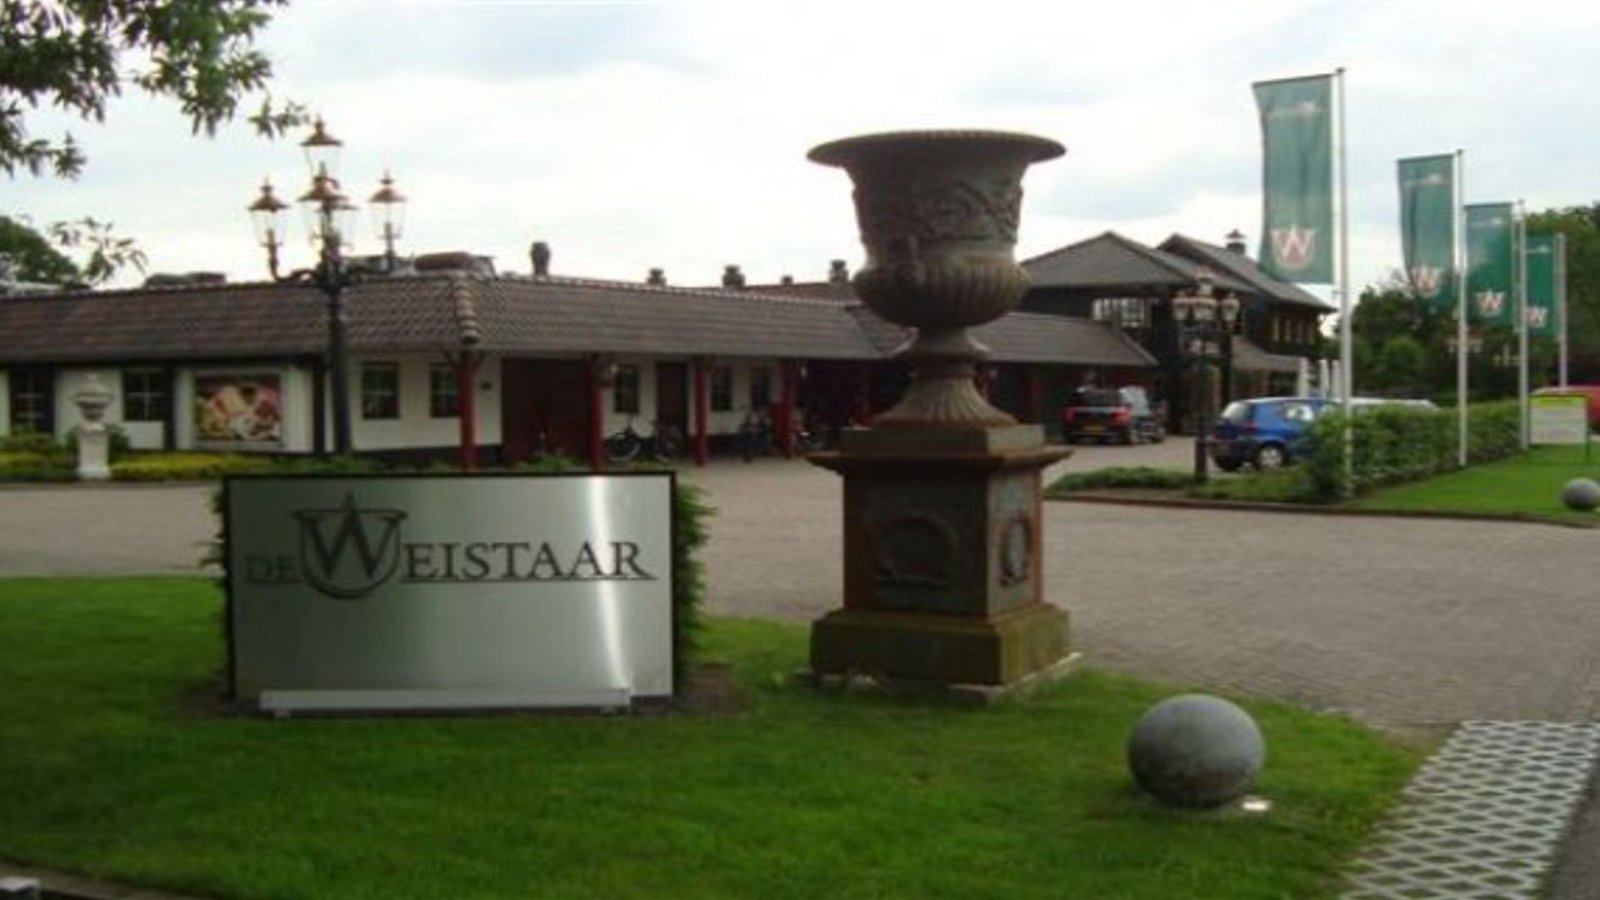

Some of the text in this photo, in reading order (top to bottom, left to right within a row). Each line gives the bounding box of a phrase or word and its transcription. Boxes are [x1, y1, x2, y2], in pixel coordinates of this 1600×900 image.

[1271, 225, 1316, 268] W
[246, 491, 655, 598] DE WEISTAAR
